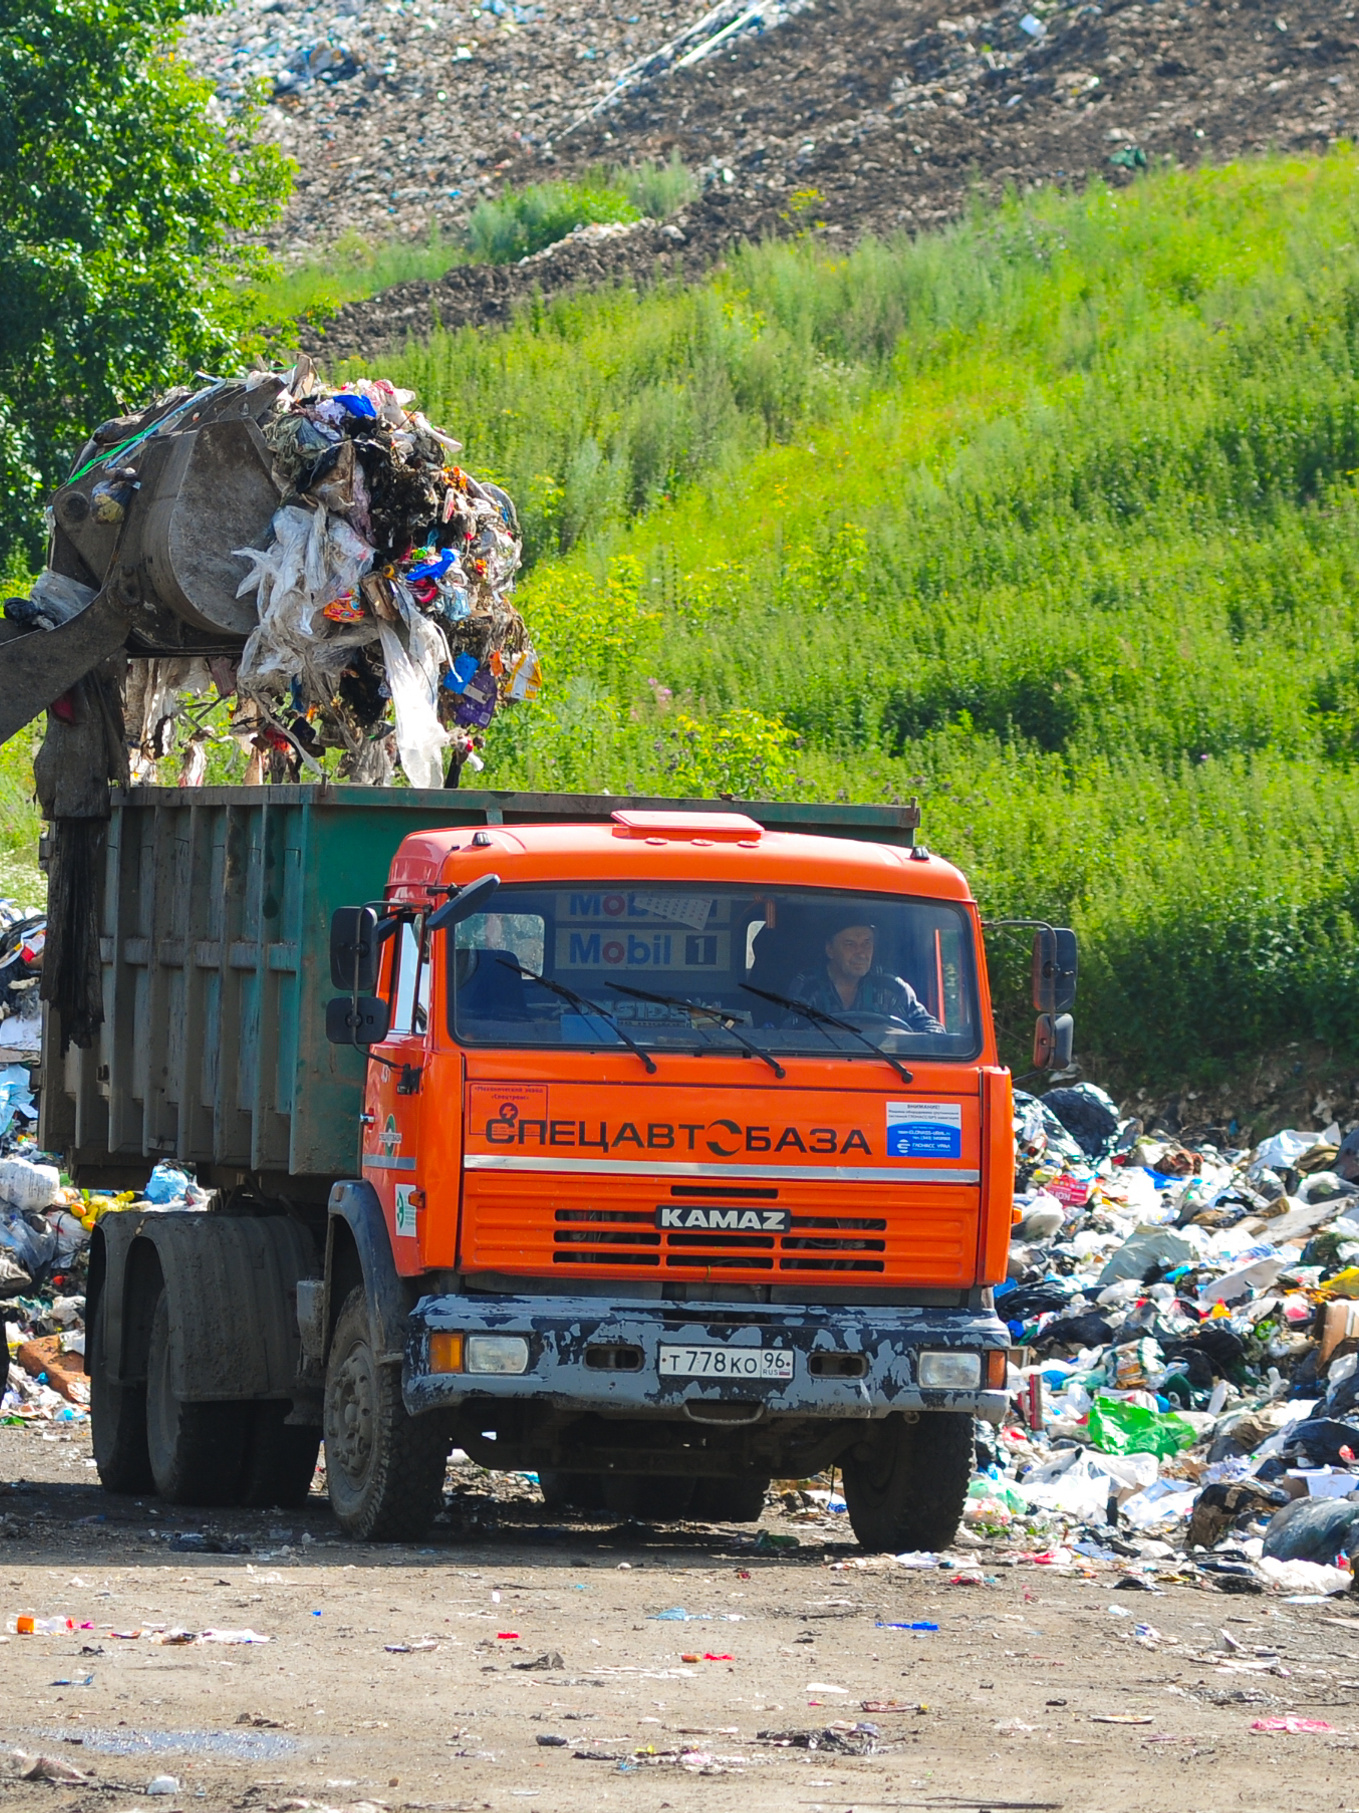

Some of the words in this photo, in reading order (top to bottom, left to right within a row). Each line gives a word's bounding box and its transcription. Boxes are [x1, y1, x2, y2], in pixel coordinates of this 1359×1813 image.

[570, 894, 667, 920] Mob
[569, 933, 672, 965] Mobil
[486, 1118, 872, 1157] СПЕЦАВТОБАЗА
[660, 1208, 786, 1231] KAMAZ
[763, 1352, 786, 1369] 96
